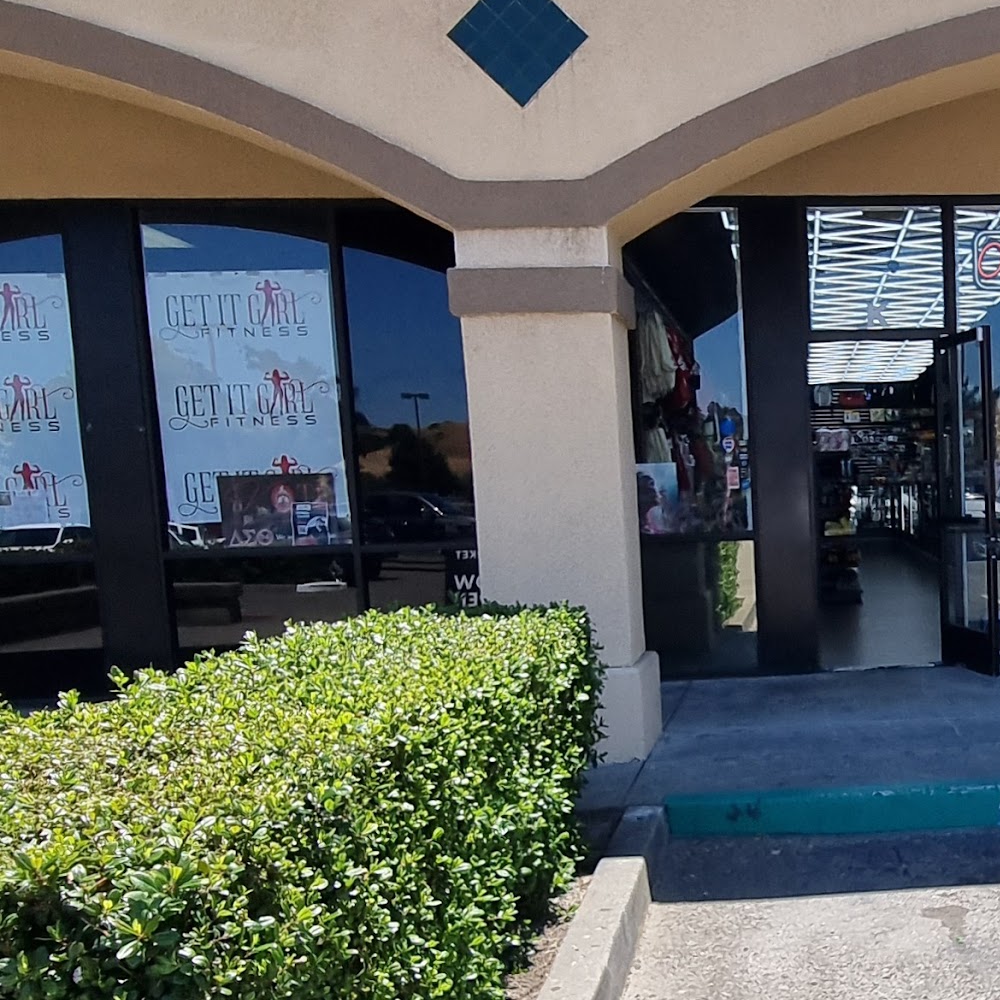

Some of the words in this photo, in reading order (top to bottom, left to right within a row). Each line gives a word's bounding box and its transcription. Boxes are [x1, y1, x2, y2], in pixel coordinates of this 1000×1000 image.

[165, 293, 210, 328] GET
[216, 294, 241, 327] IT
[200, 325, 309, 339] FITNESS
[175, 383, 220, 418] GET
[226, 384, 250, 416] IT
[209, 414, 318, 428] FITNESS
[184, 471, 218, 504] GE
